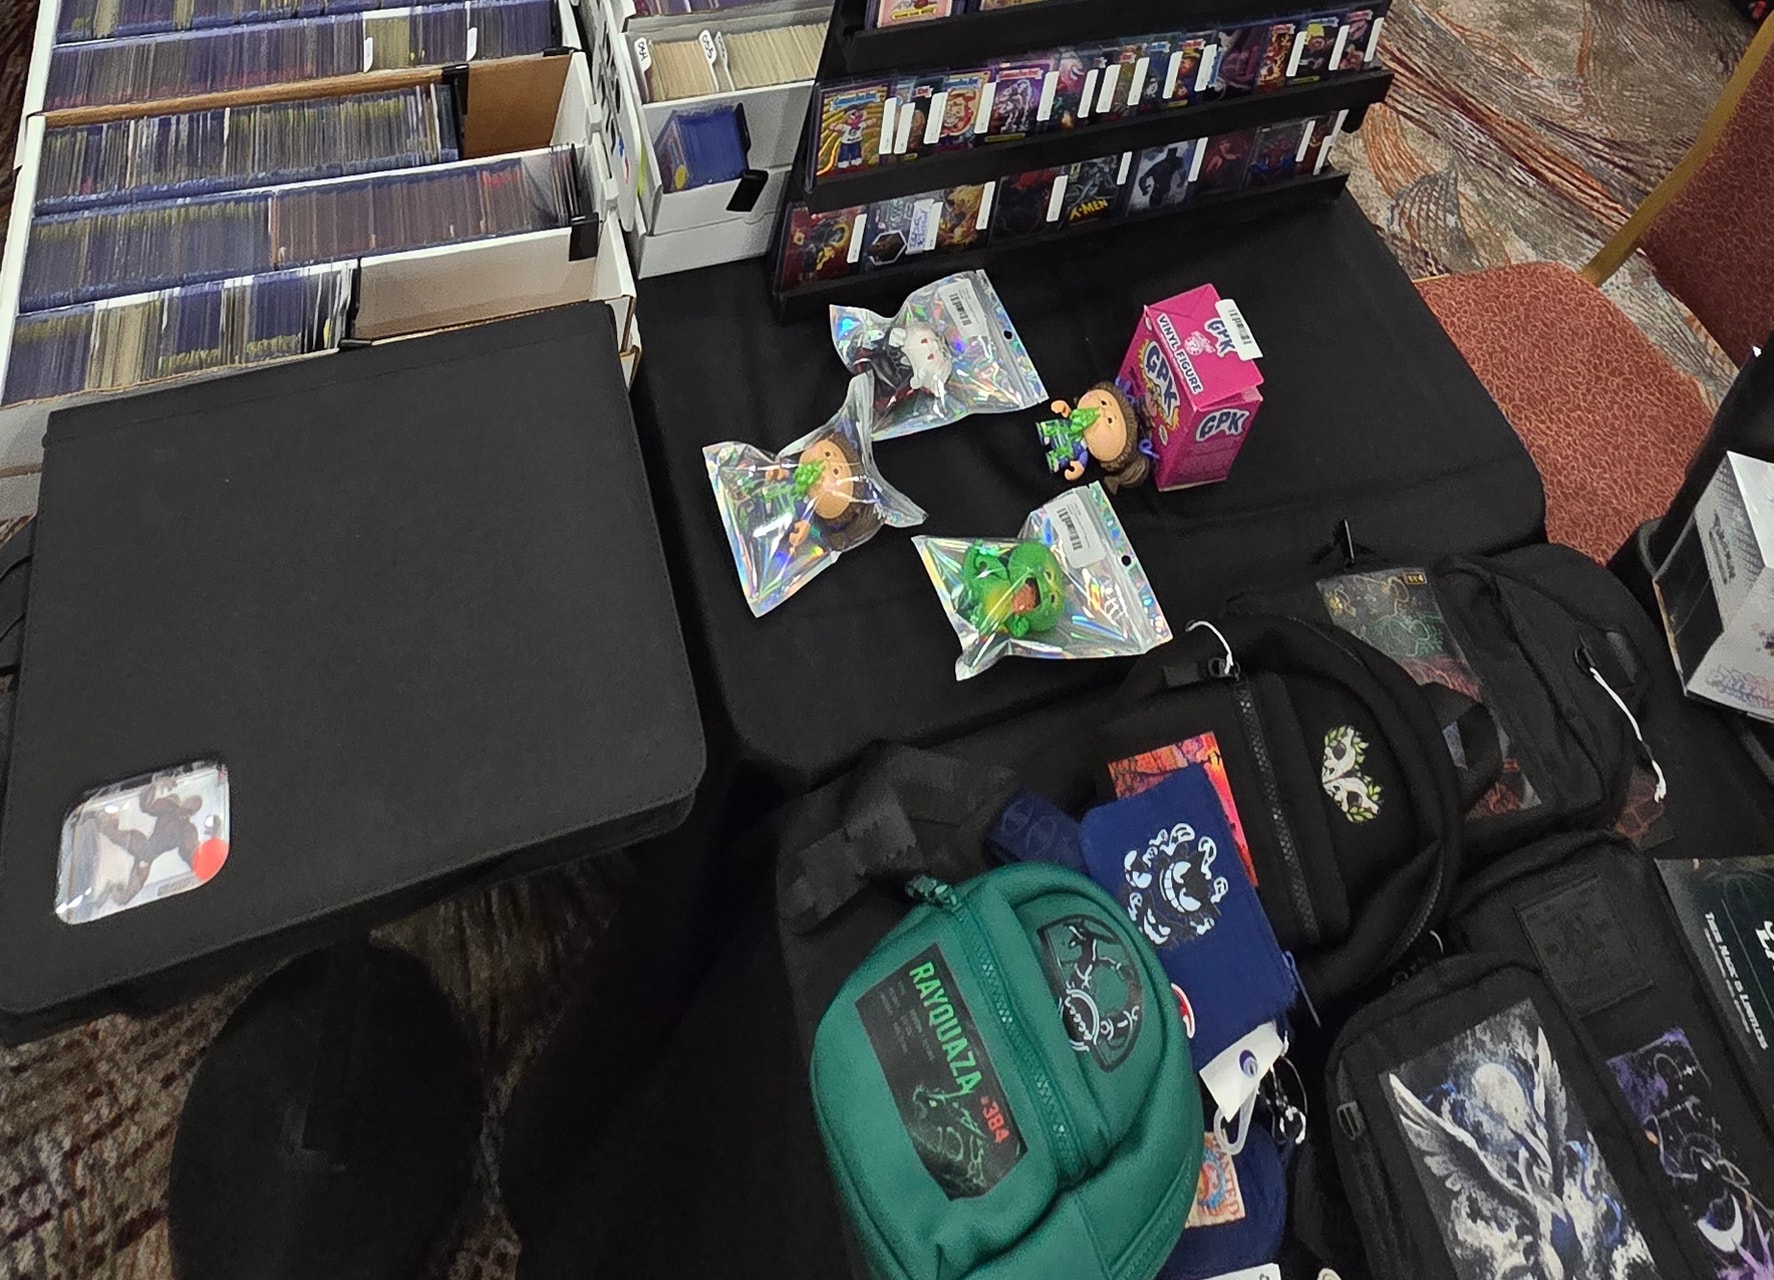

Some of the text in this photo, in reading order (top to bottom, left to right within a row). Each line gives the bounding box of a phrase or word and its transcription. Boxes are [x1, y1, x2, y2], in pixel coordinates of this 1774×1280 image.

[1146, 344, 1178, 420] GPK
[1158, 315, 1202, 392] VINYL FIGURE
[1199, 411, 1248, 439] GPK
[908, 961, 984, 1096] RAYQUAZA
